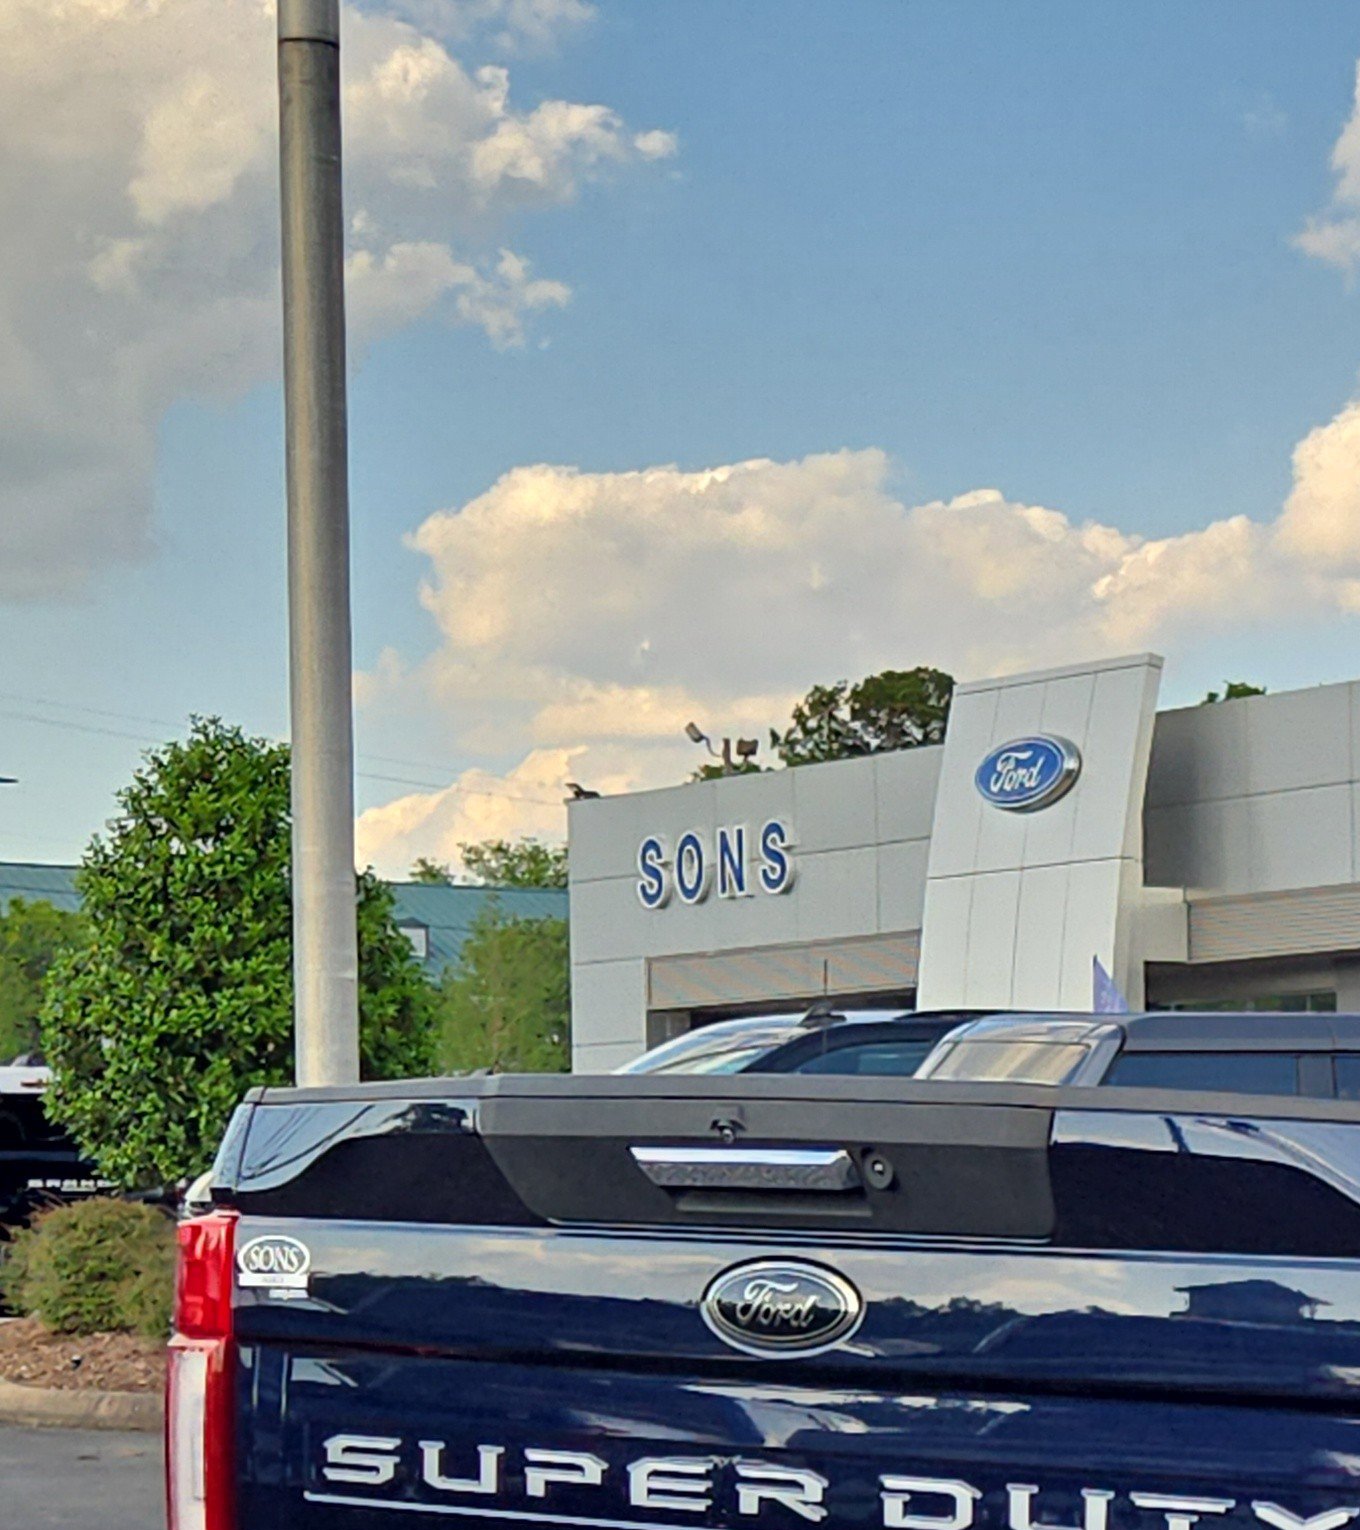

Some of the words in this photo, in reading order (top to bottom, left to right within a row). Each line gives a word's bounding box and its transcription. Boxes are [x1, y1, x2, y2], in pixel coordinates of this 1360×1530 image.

[990, 751, 1046, 793] Ford
[638, 818, 790, 908] SONS
[249, 1245, 300, 1272] SONS
[735, 1279, 820, 1328] Ford
[322, 1433, 830, 1522] SUPER
